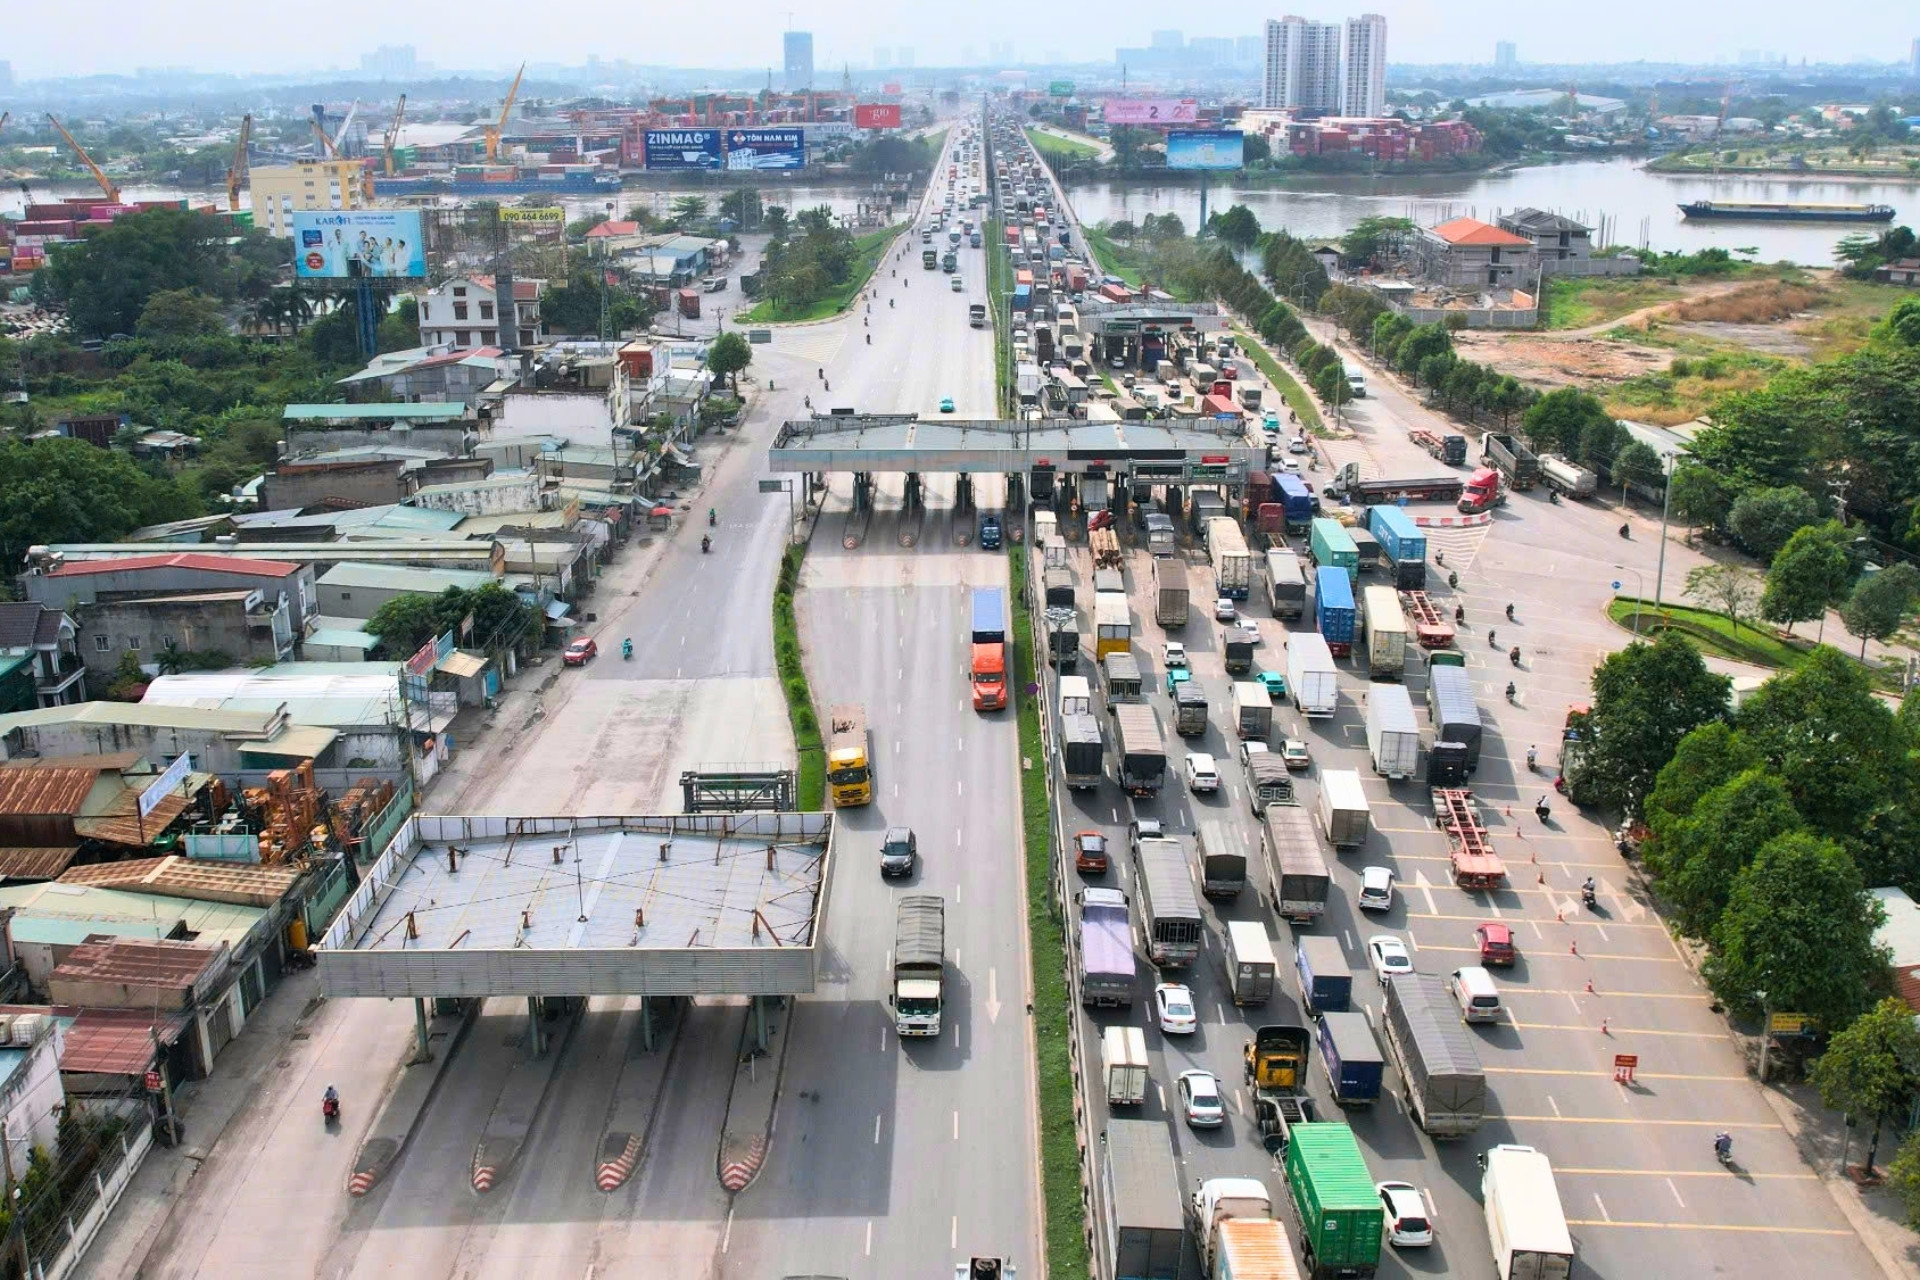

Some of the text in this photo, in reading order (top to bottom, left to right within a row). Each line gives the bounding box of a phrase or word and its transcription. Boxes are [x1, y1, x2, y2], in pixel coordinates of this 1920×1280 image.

[1149, 106, 1158, 118] 2
[648, 133, 704, 144] ZINMAG
[504, 213, 559, 221] 090 464 6699
